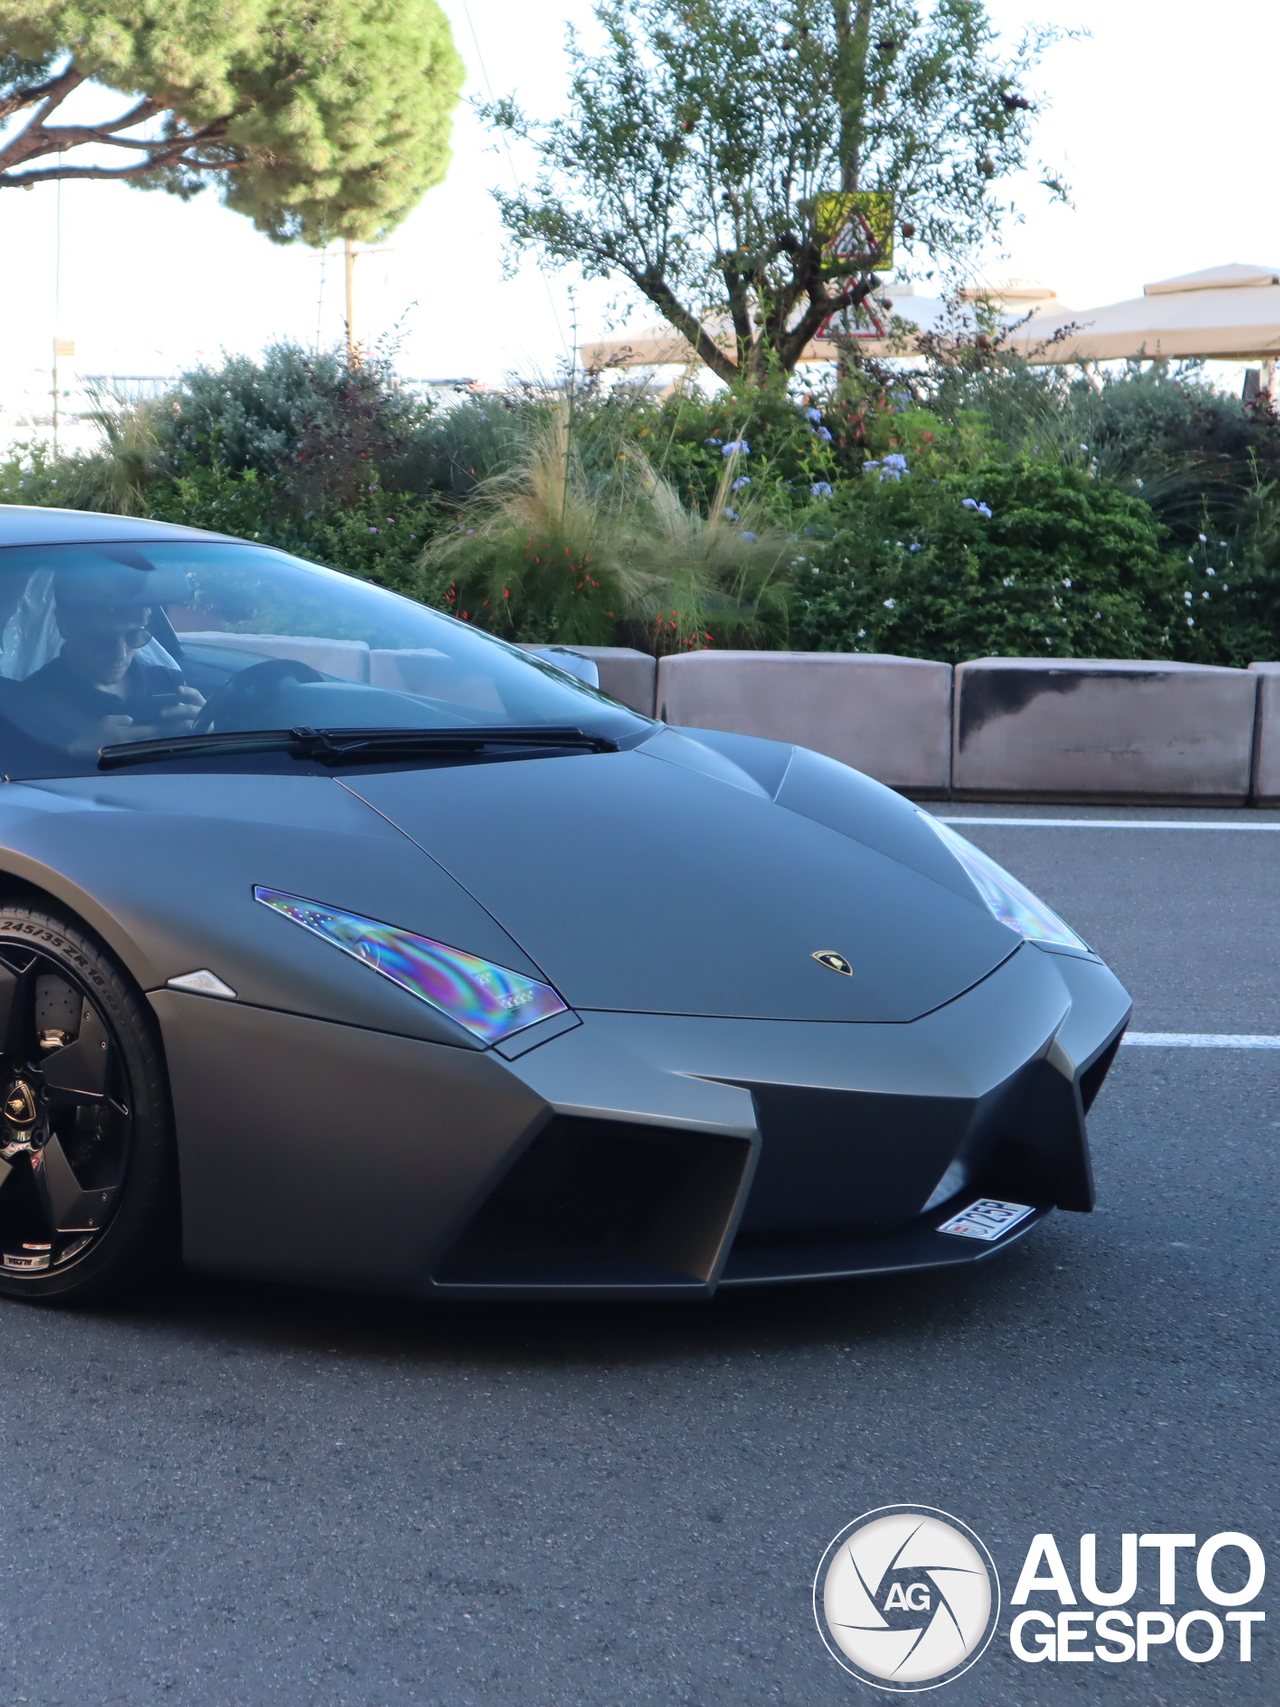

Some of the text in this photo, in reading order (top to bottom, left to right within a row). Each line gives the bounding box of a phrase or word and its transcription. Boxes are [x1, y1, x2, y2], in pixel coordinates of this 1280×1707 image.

[0, 920, 64, 948] 245/35
[62, 945, 89, 967] ZR
[88, 968, 105, 986] 18
[954, 1201, 1020, 1230] 725P
